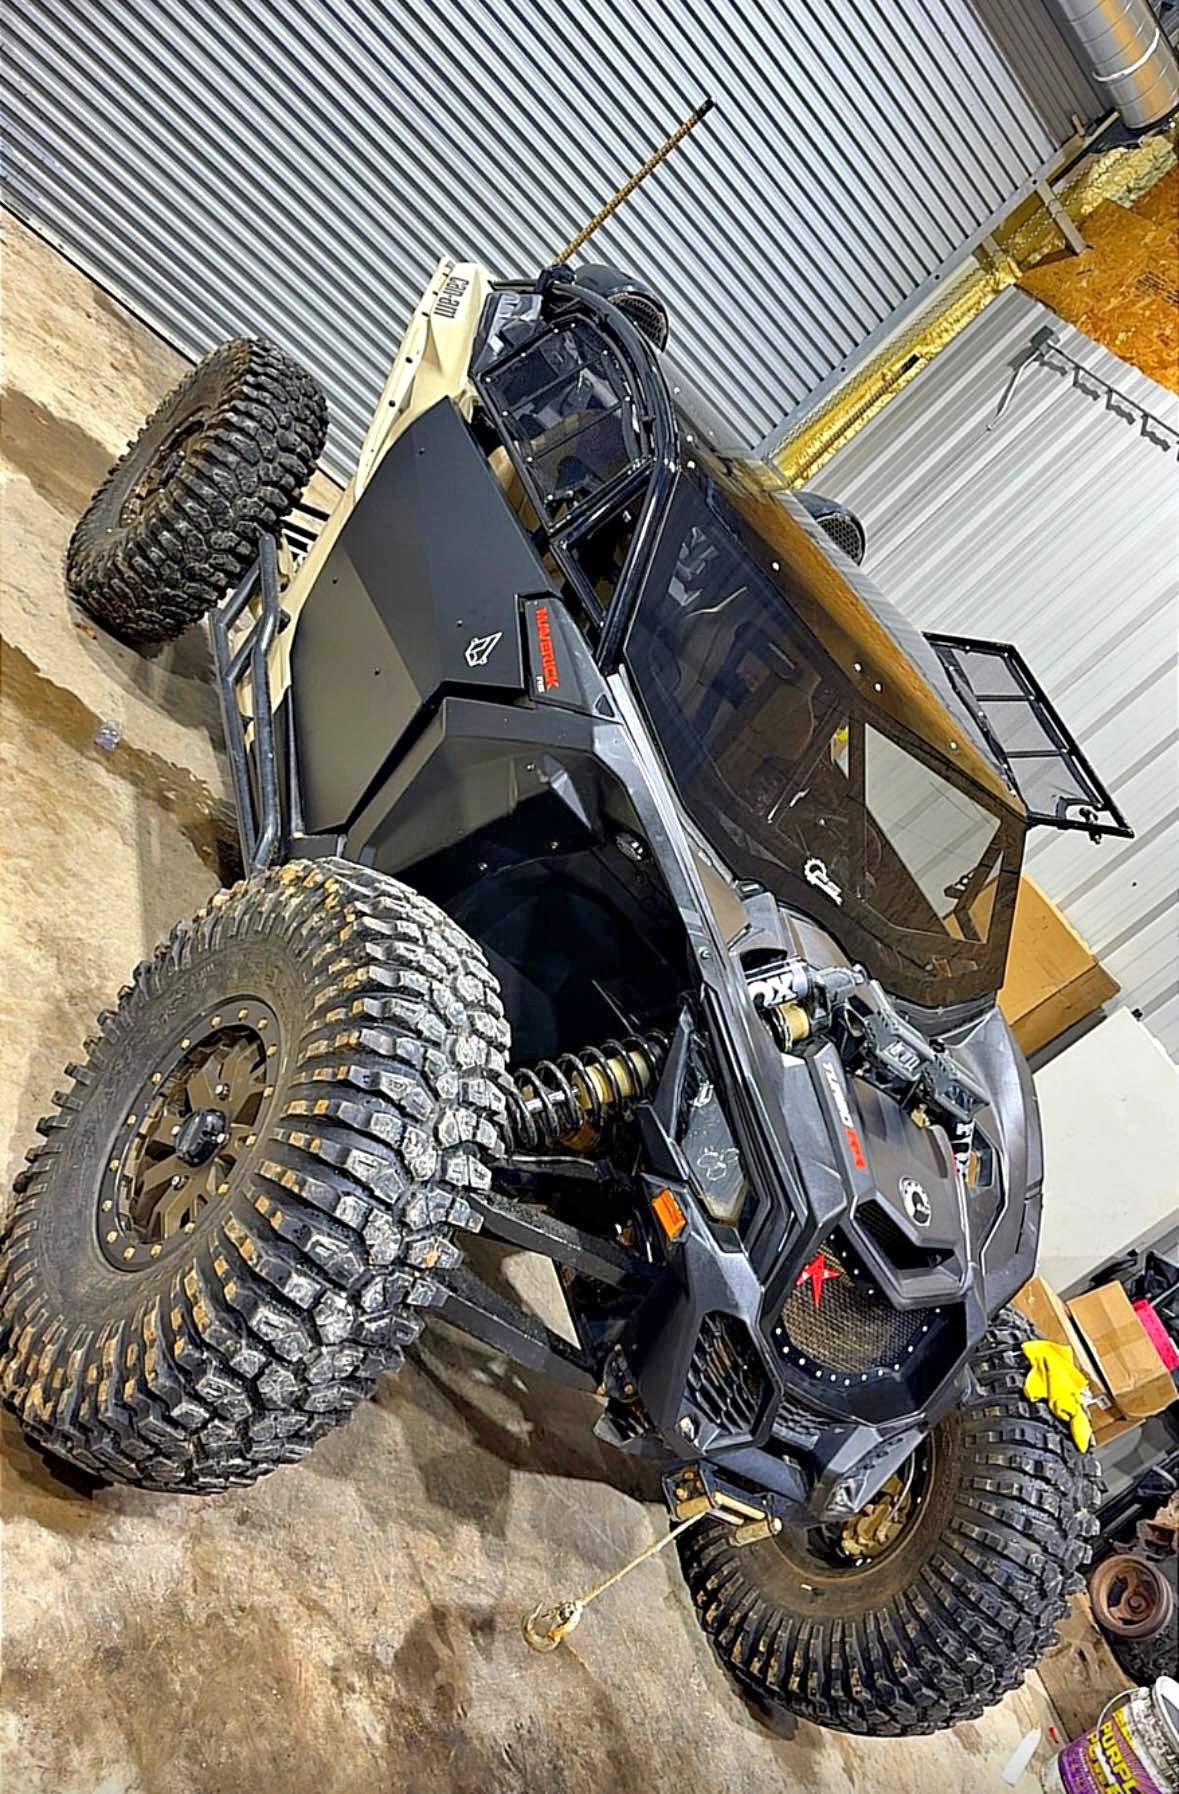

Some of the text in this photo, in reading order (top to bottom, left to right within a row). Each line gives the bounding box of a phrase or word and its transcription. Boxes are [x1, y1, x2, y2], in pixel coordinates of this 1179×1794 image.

[433, 276, 469, 319] can-am
[535, 606, 559, 690] MAVERICK
[747, 972, 797, 1007] OX
[1100, 1721, 1138, 1794] PURPL
